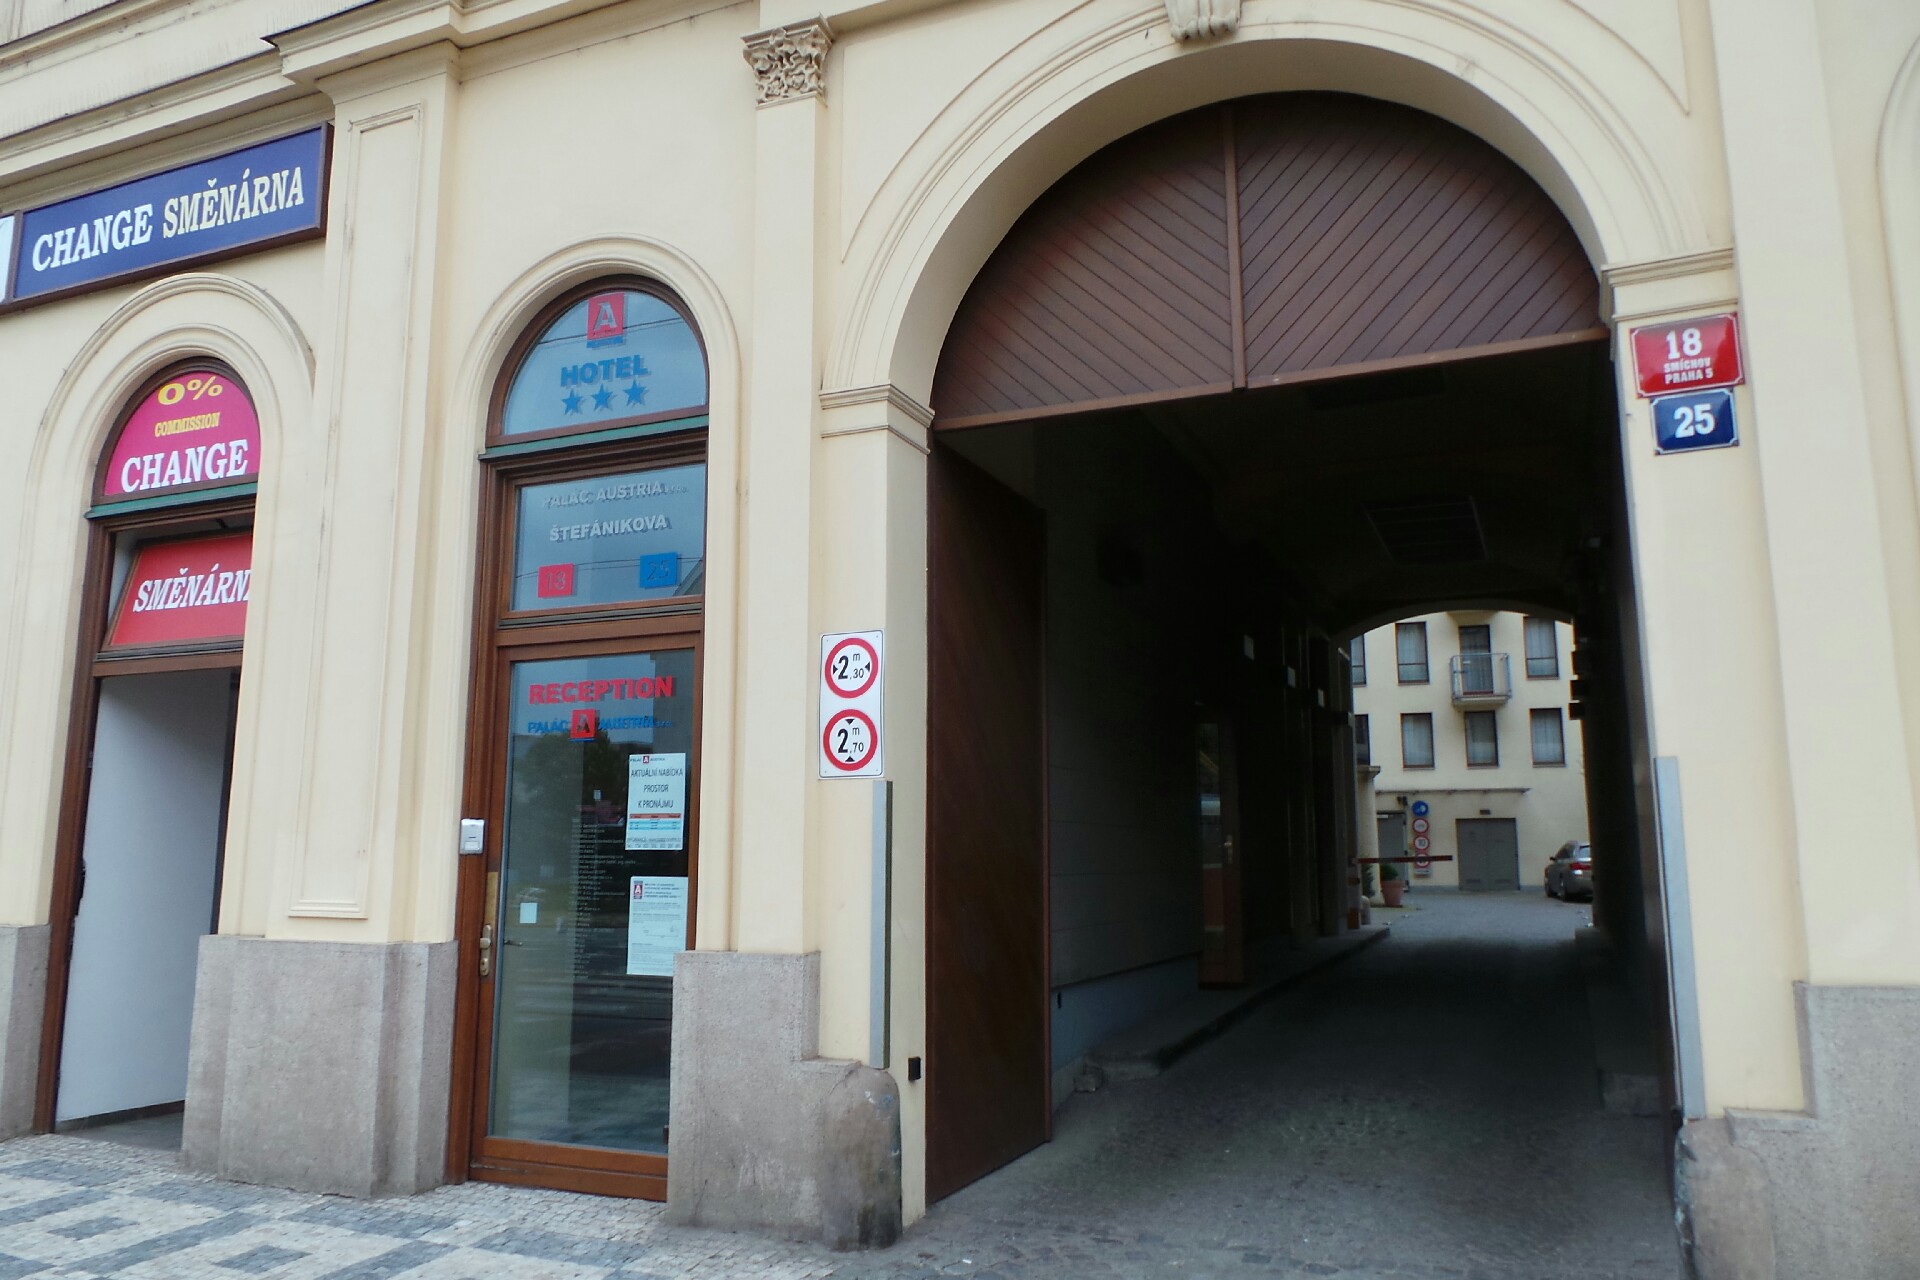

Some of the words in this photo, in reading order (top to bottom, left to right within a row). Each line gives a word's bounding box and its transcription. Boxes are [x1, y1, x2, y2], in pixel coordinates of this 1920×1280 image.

[32, 204, 153, 272] CHANGE
[163, 167, 305, 239] SMĚNÁRNA
[594, 302, 617, 330] A
[1667, 328, 1702, 359] 18
[561, 355, 649, 387] HOTEL
[1664, 358, 1710, 373] SMÍCHOV
[1665, 371, 1703, 383] PRAHA
[1706, 368, 1713, 378] 5
[157, 376, 223, 405] 0%
[154, 412, 220, 437] COMMISSION
[1674, 404, 1715, 438] 25
[121, 439, 249, 493] CHANGE
[549, 514, 668, 542] ŠTEFÁNIKOVA
[647, 559, 670, 581] 25
[528, 675, 674, 704] RECEPTION
[643, 784, 669, 793] PROSTOR
[642, 798, 674, 809] PRONÁJMU
